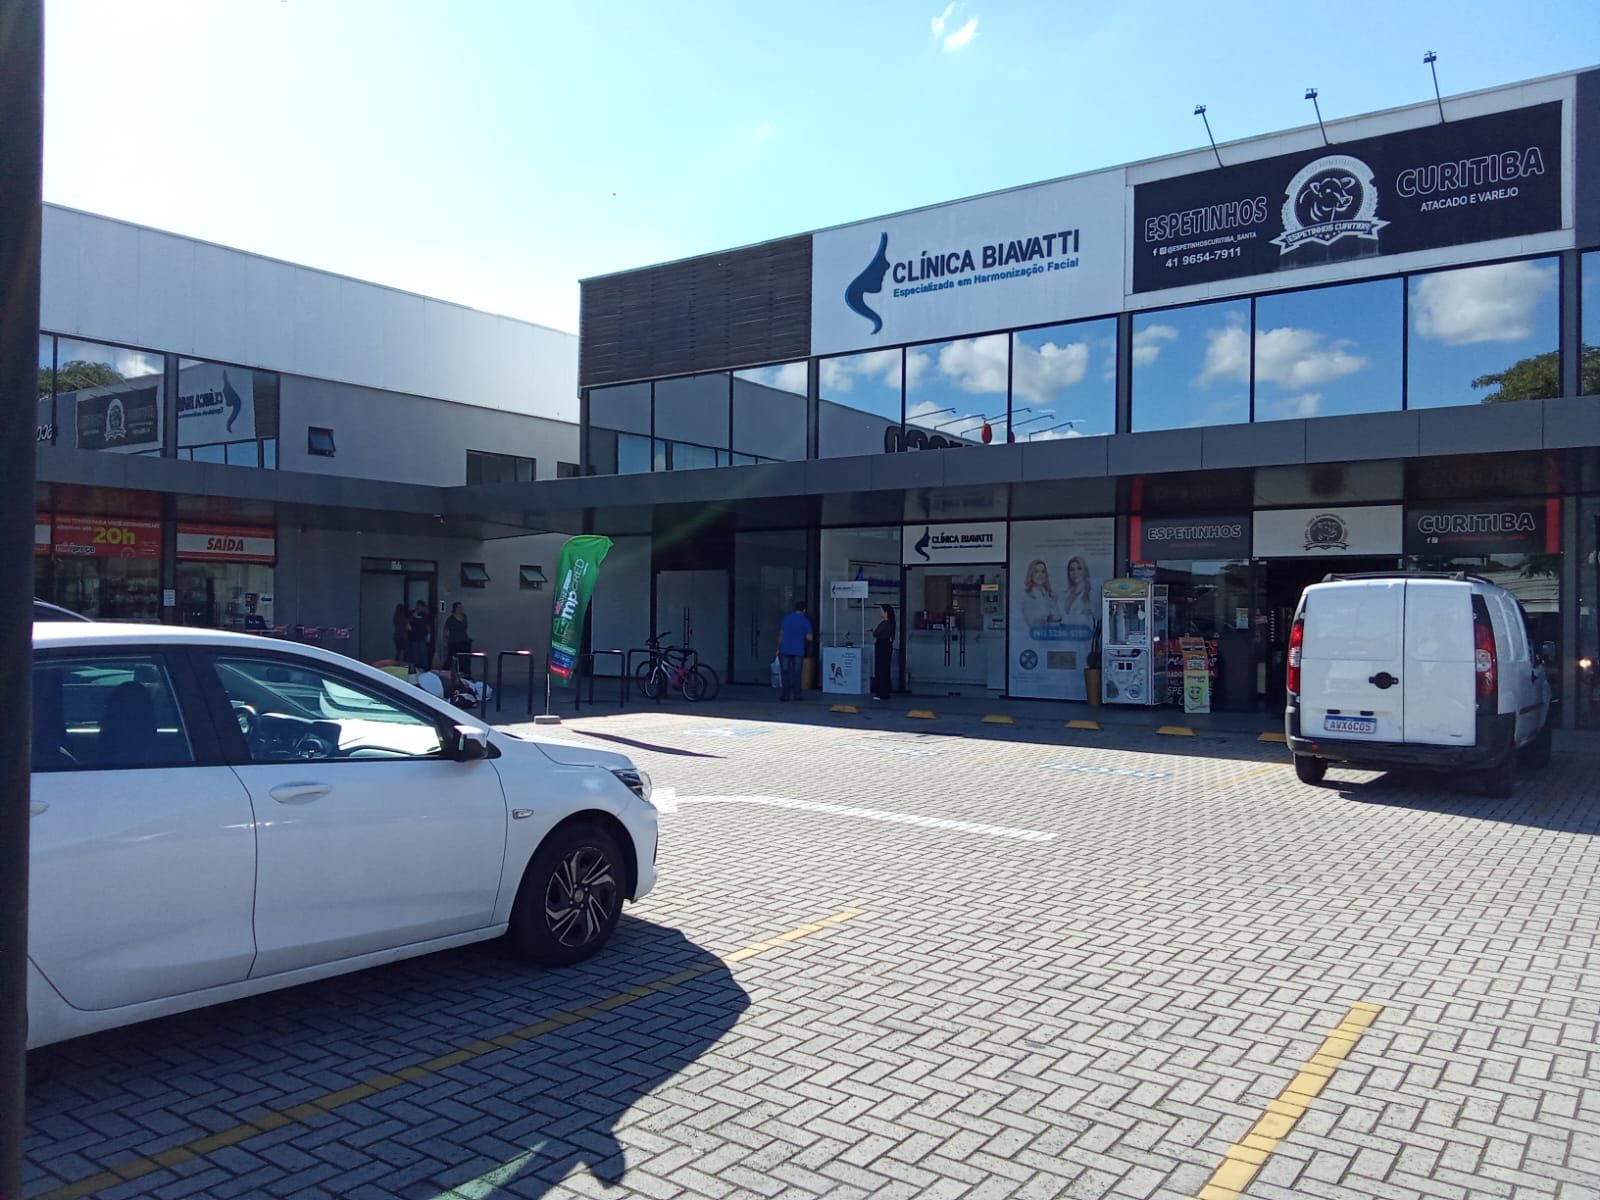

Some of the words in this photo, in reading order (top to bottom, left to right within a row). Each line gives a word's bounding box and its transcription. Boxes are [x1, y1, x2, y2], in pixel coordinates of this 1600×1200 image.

[1396, 146, 1545, 198] CURITIBA
[1420, 195, 1468, 212] ATACADO
[1469, 193, 1477, 204] E
[1478, 187, 1519, 202] VAREJO
[1144, 196, 1268, 242] ESPETINHOS
[892, 249, 975, 284] CLÍNICA
[982, 229, 1080, 269] BIAVATTI
[1165, 257, 1179, 268] 41
[1182, 247, 1241, 266] 9654-7911
[893, 279, 955, 298] Especializada
[957, 277, 972, 287] em
[974, 263, 1045, 285] Harmonização
[1047, 257, 1079, 273] Facial
[1147, 524, 1242, 540] ESPETINHOS
[1417, 512, 1536, 534] CURITIBA
[92, 526, 136, 545] 20h
[206, 535, 244, 552] SAÍDA
[931, 532, 960, 544] CLÍNICA
[960, 533, 993, 543] BIAVATTI
